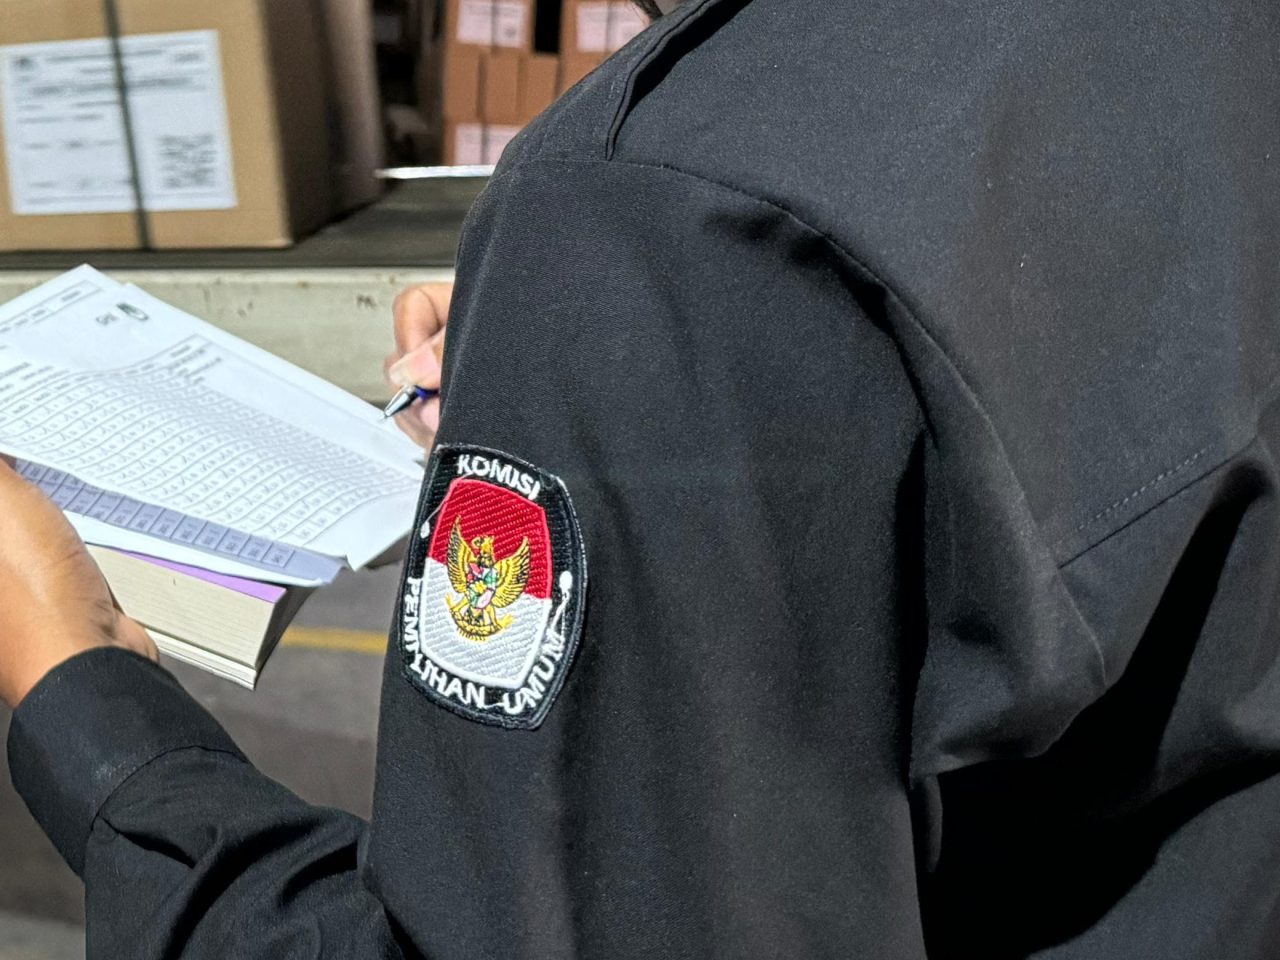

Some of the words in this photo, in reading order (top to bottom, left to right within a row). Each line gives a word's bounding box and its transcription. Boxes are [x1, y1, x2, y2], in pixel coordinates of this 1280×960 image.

[457, 454, 541, 500] KOMISI
[404, 577, 488, 708] PEMILIHAN
[503, 628, 566, 715] UMUM
